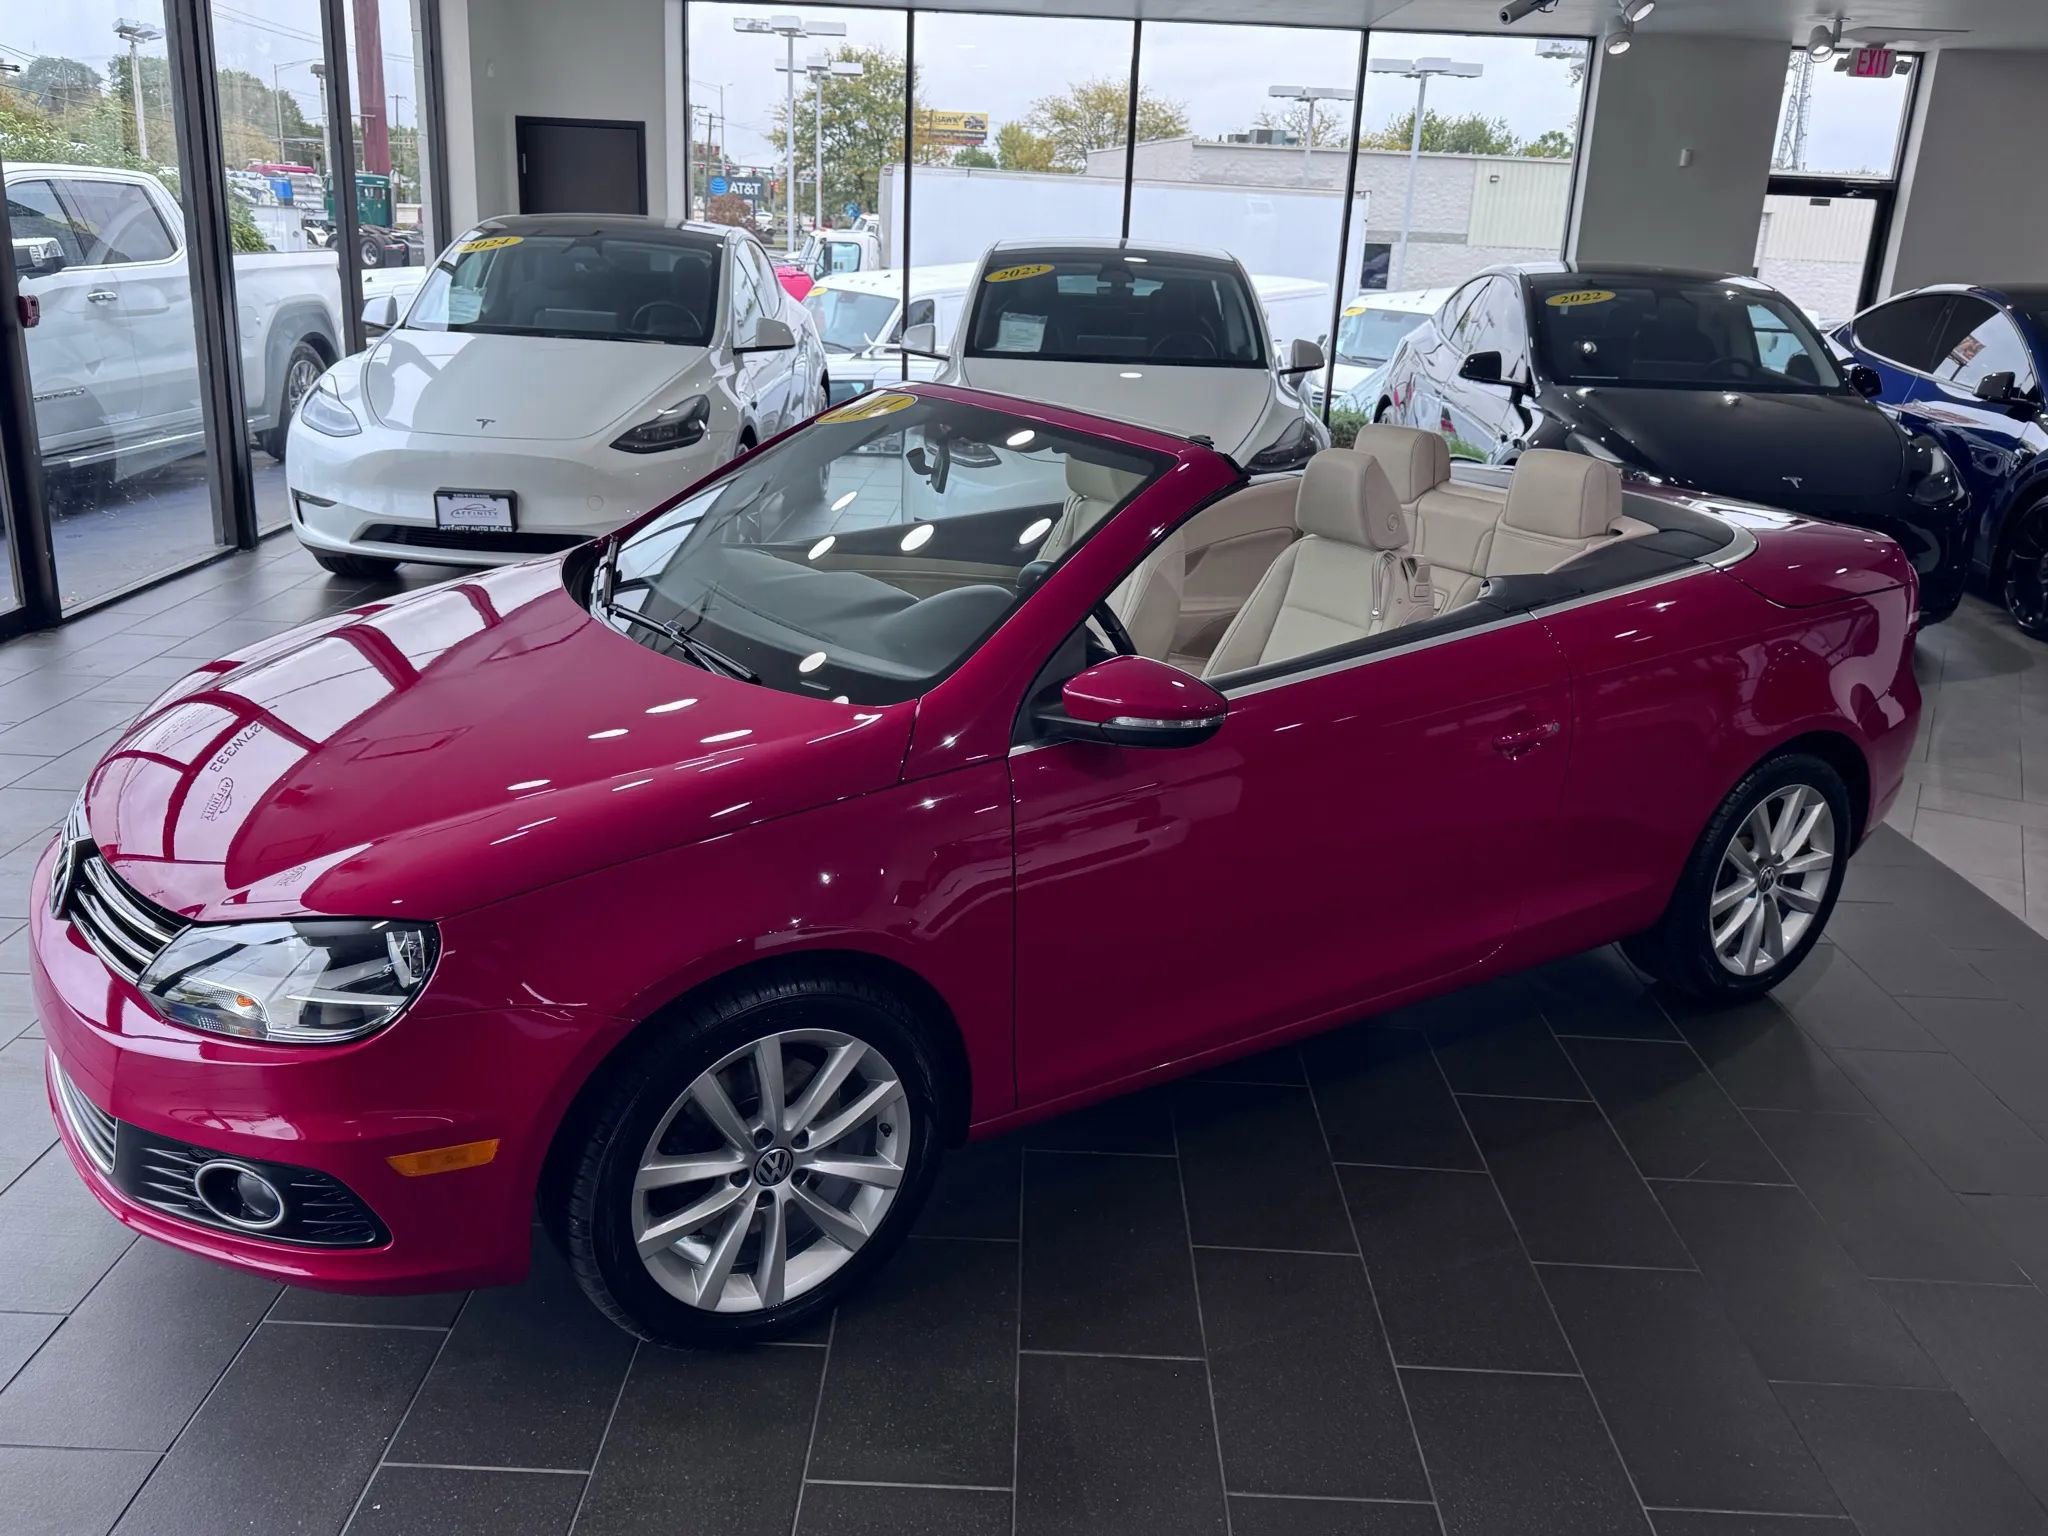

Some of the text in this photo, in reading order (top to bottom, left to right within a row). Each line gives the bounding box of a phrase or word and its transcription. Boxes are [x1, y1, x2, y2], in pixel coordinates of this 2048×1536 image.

[1856, 49, 1892, 76] EXIT
[729, 181, 761, 195] AT&T
[999, 266, 1041, 280] 2023
[1560, 292, 1601, 304] 2022
[439, 524, 470, 532] AFFINITY
[209, 723, 263, 773] 27W333
[204, 781, 231, 821] AFFINITY
